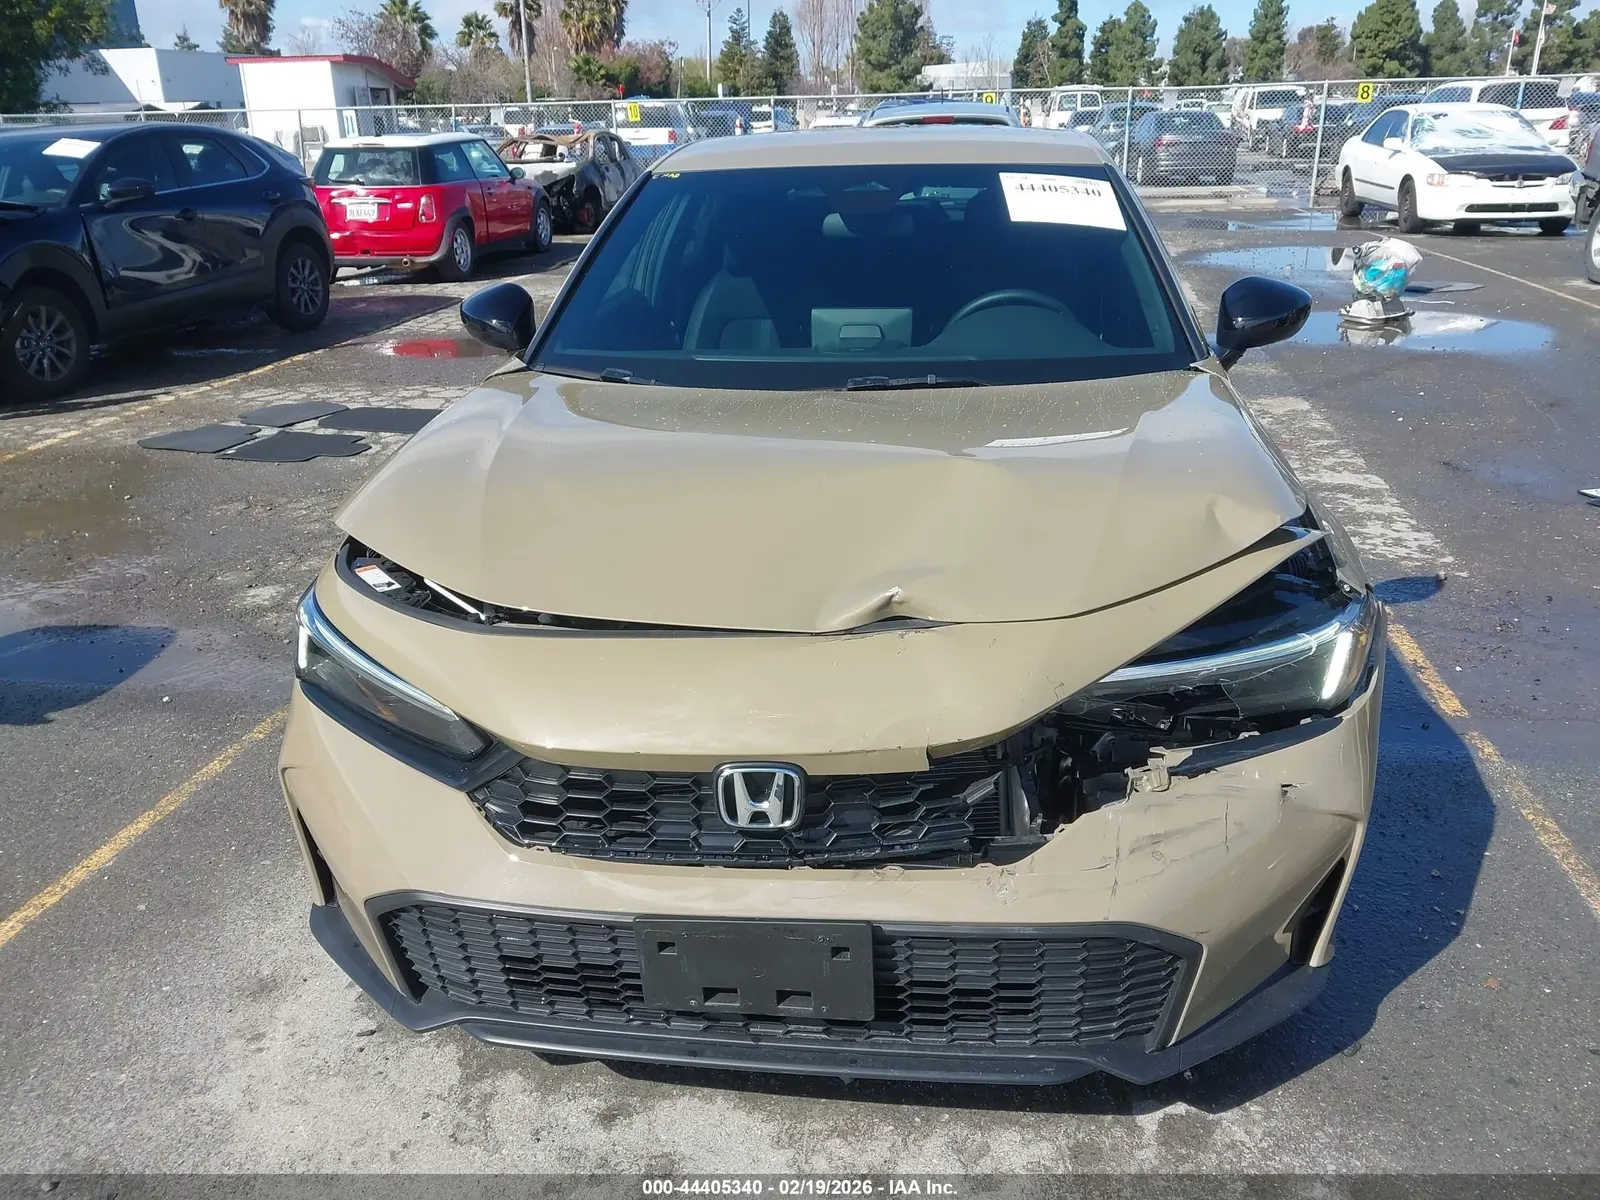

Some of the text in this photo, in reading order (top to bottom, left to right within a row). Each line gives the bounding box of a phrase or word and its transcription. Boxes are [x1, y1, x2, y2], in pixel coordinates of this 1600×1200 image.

[1360, 85, 1370, 100] 8
[628, 104, 638, 118] 10
[1015, 183, 1101, 197] 44405340
